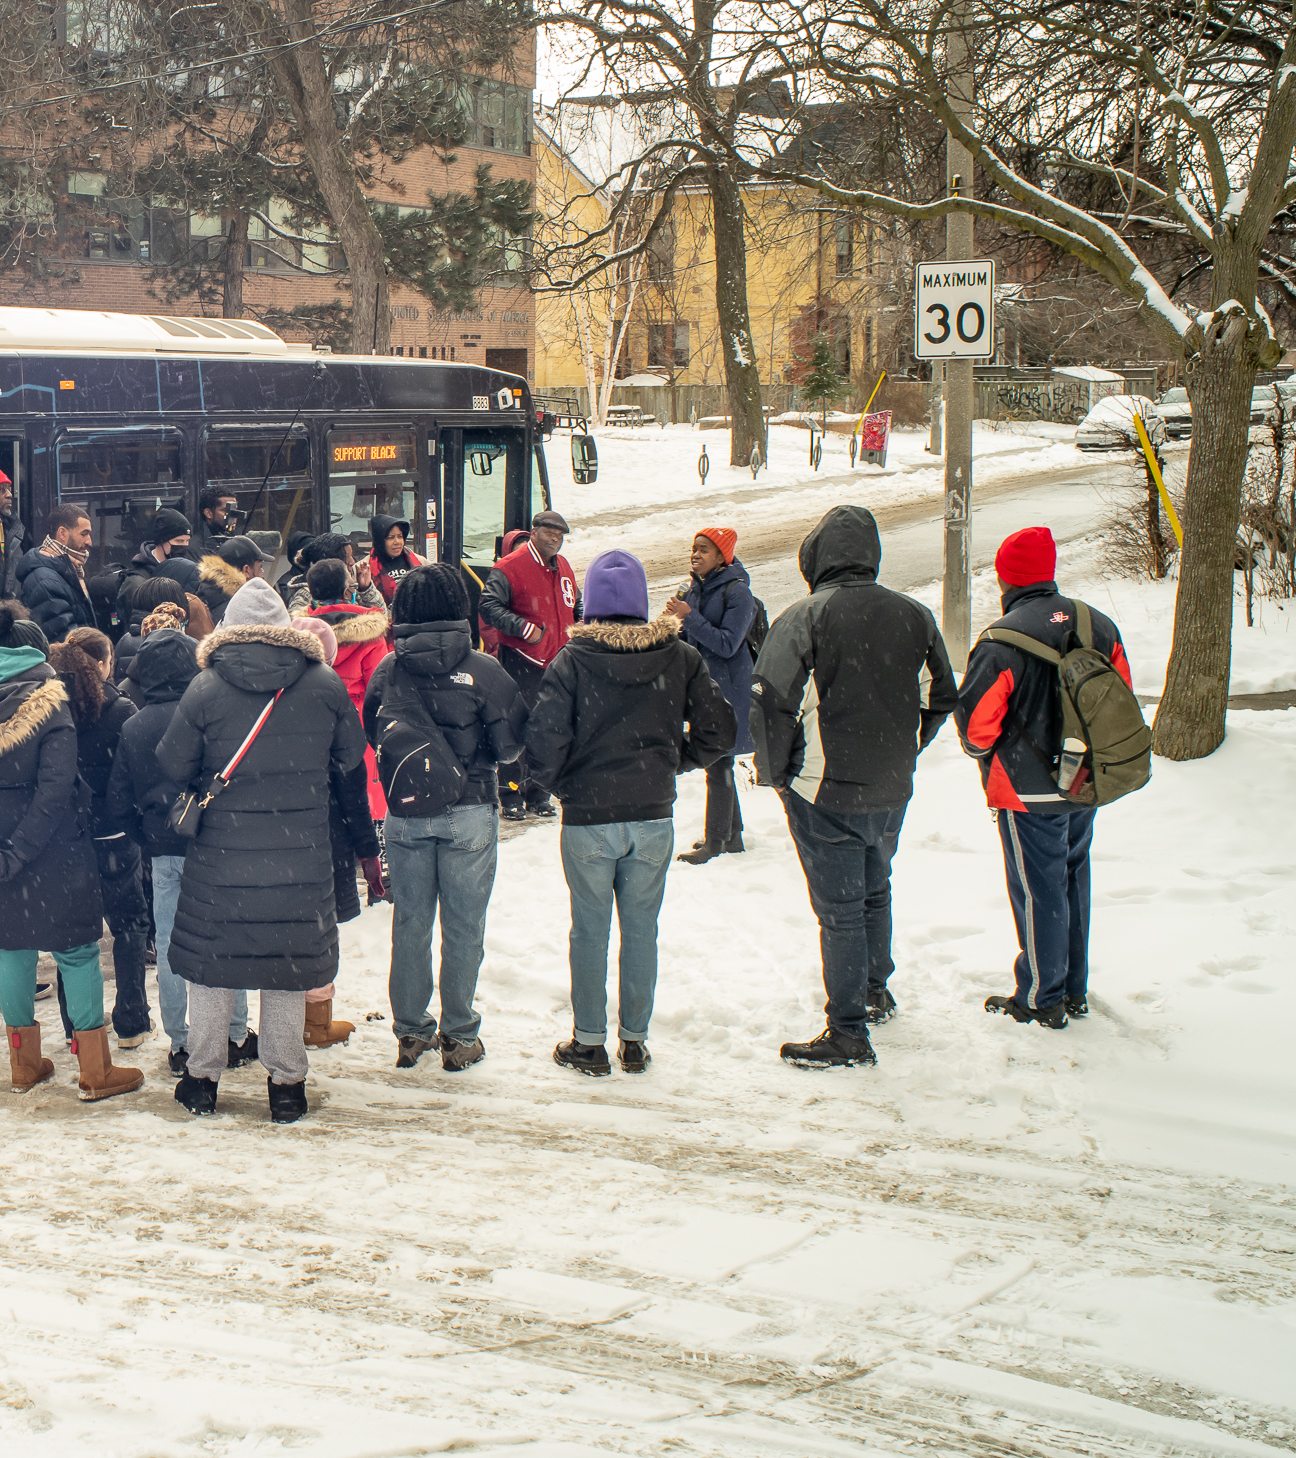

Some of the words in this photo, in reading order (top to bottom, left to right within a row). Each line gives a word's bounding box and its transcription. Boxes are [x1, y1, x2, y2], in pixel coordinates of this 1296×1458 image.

[923, 271, 987, 288] MAXIMUM
[392, 307, 420, 320] UNITED
[923, 301, 986, 345] 30
[473, 397, 489, 409] 8883
[334, 447, 367, 462] SUPPORT
[370, 445, 396, 460] BLACK
